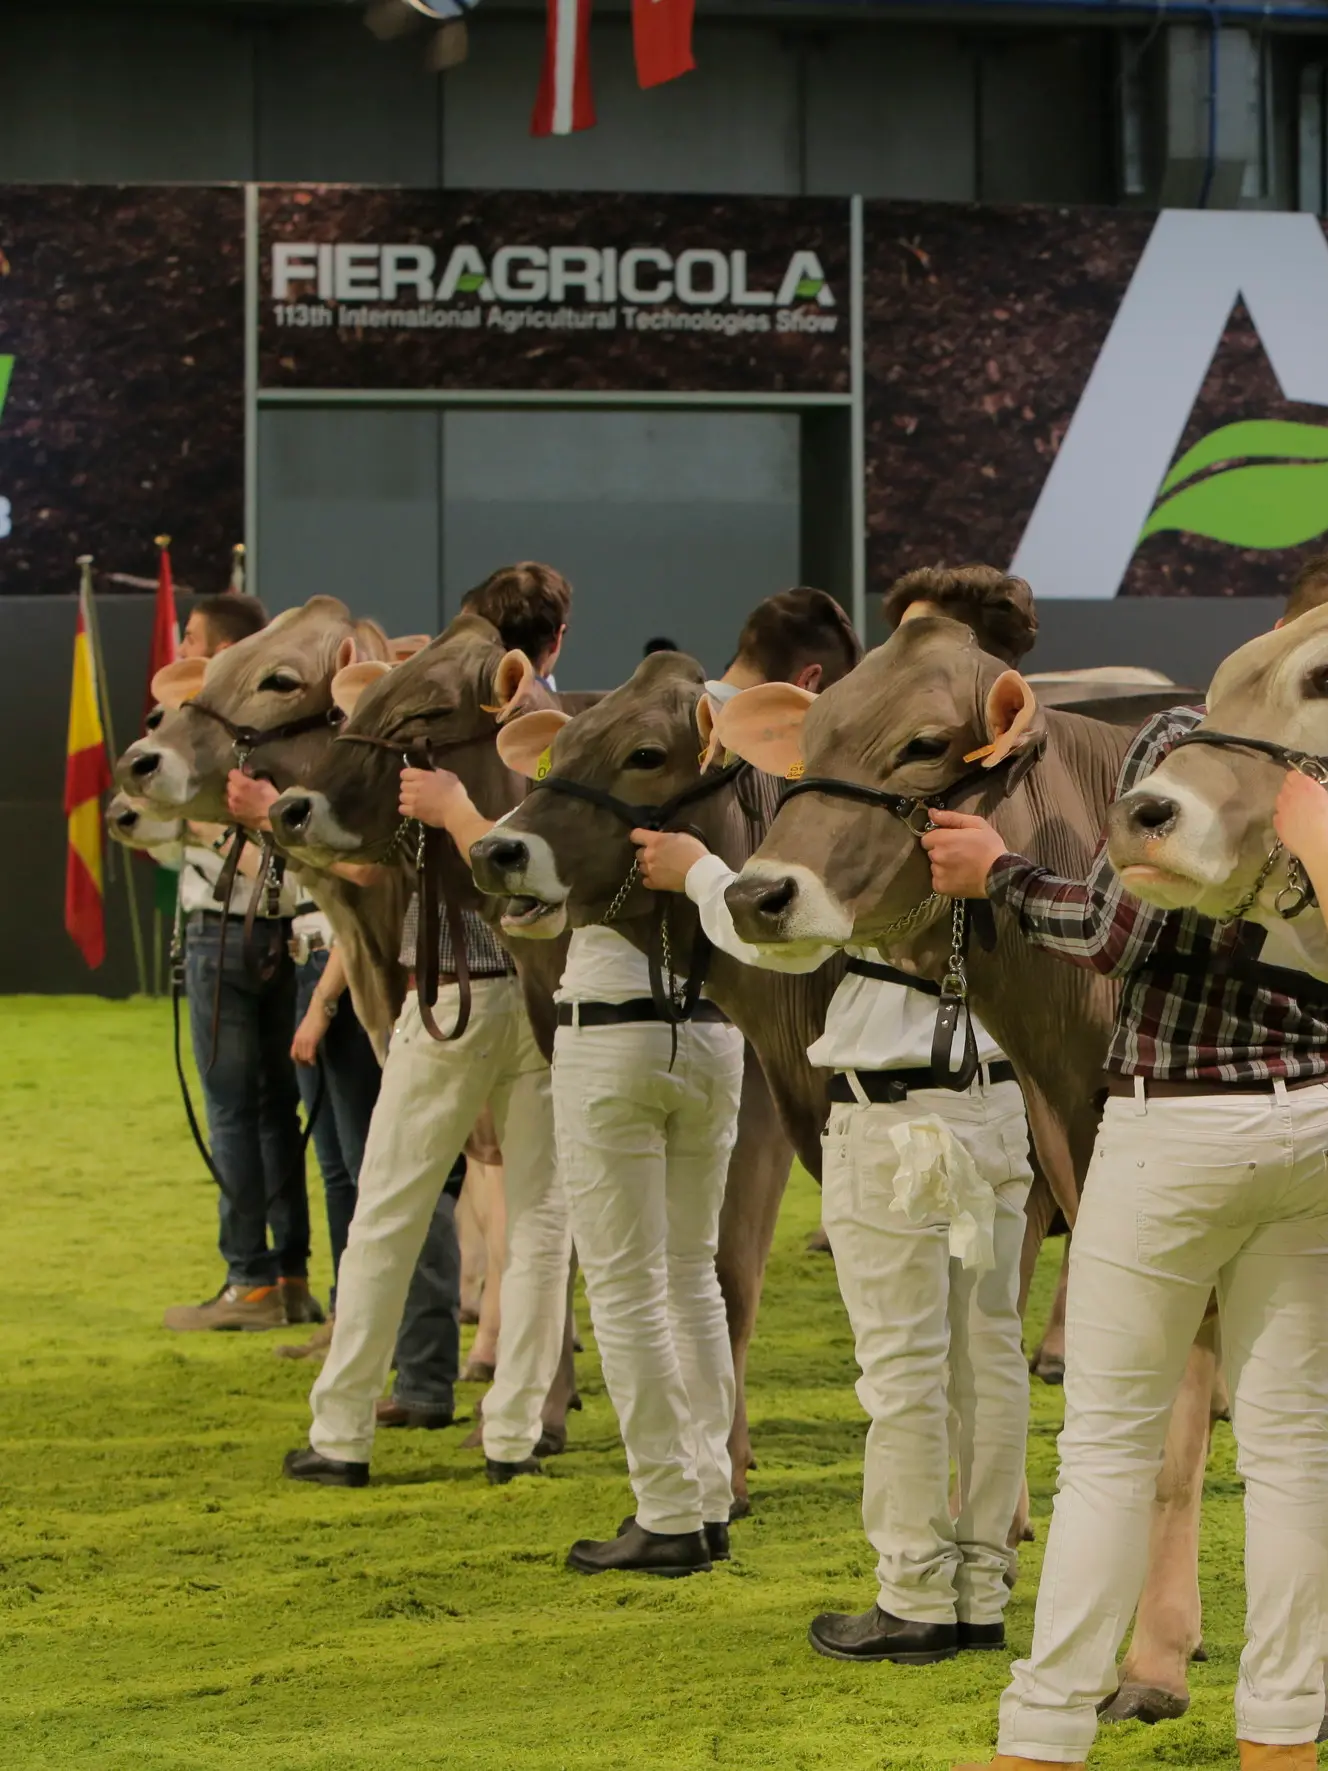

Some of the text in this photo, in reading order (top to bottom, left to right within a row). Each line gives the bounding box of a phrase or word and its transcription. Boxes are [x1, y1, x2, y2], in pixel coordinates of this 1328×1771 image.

[271, 242, 836, 307] FIERAGRICOLA
[274, 304, 838, 337] 113th International Agricultural Technologies Show
